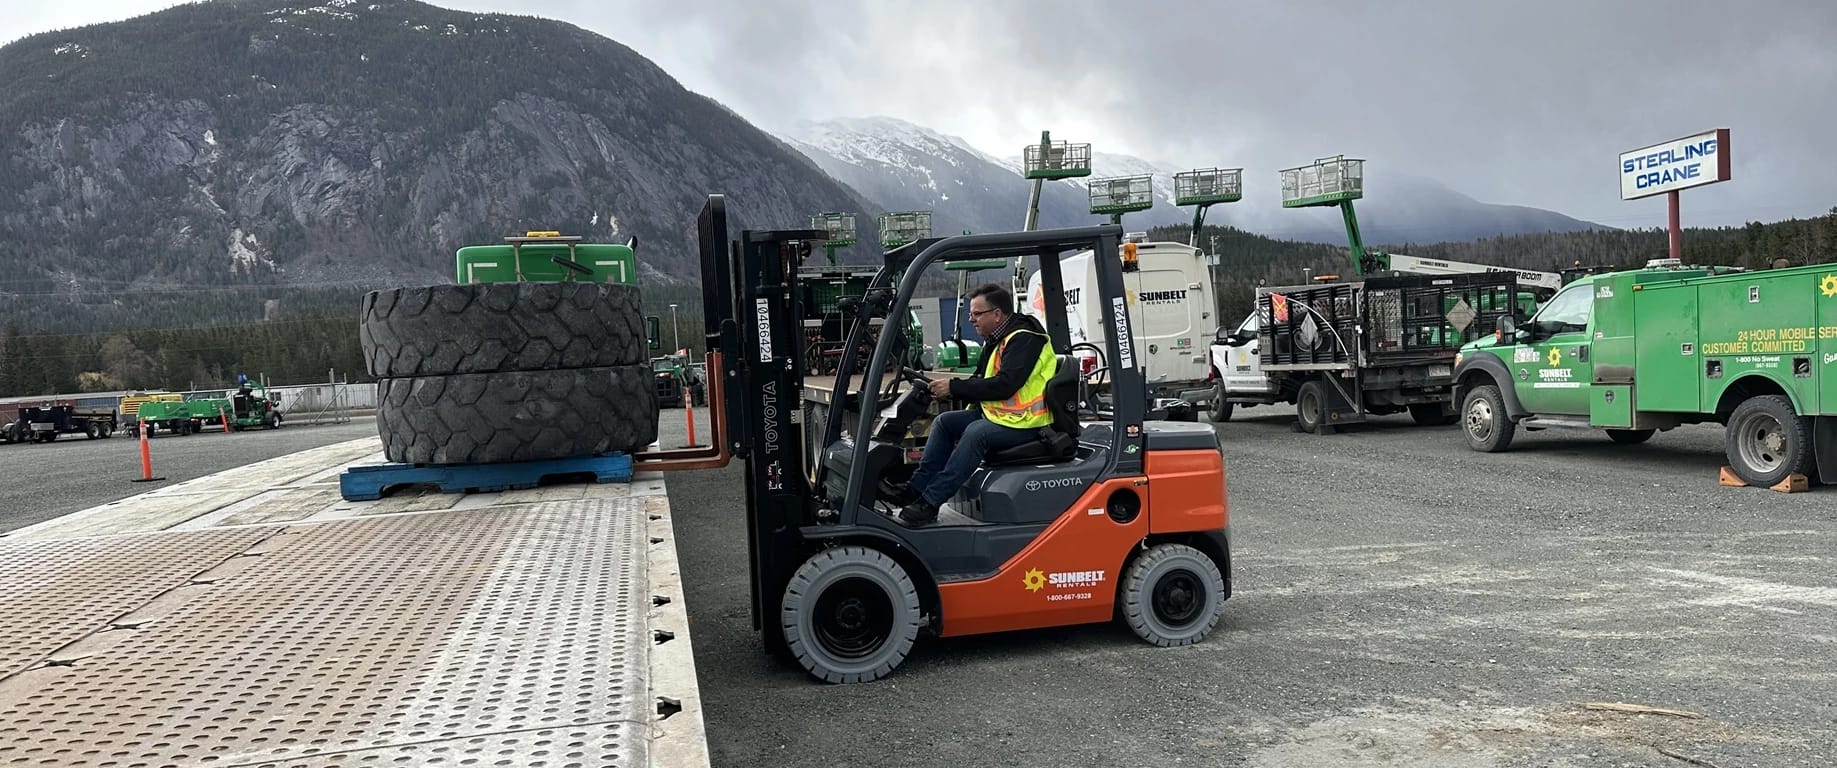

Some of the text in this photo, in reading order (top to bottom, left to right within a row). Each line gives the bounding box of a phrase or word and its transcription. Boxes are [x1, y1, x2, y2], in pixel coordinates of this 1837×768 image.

[1623, 139, 1717, 173] STERLING
[1636, 163, 1701, 189] CRANE
[1521, 272, 1542, 281] BOOM
[1064, 287, 1080, 306] BELT
[1139, 290, 1187, 301] SUNBELT
[757, 299, 772, 361] 10466424
[1114, 303, 1131, 361] 10466424
[1737, 331, 1748, 342] 24
[1750, 329, 1776, 340] HOUR
[1779, 327, 1816, 340] MOBILE
[1702, 340, 1806, 354] CUSTOMER COMMITTED
[1538, 368, 1572, 378] SUNBELT
[763, 380, 779, 454] TOYOTA
[1042, 477, 1083, 489] TOYOTA
[1049, 570, 1105, 584] SUNBELT
[1046, 592, 1092, 602] 1-800-667-9328
